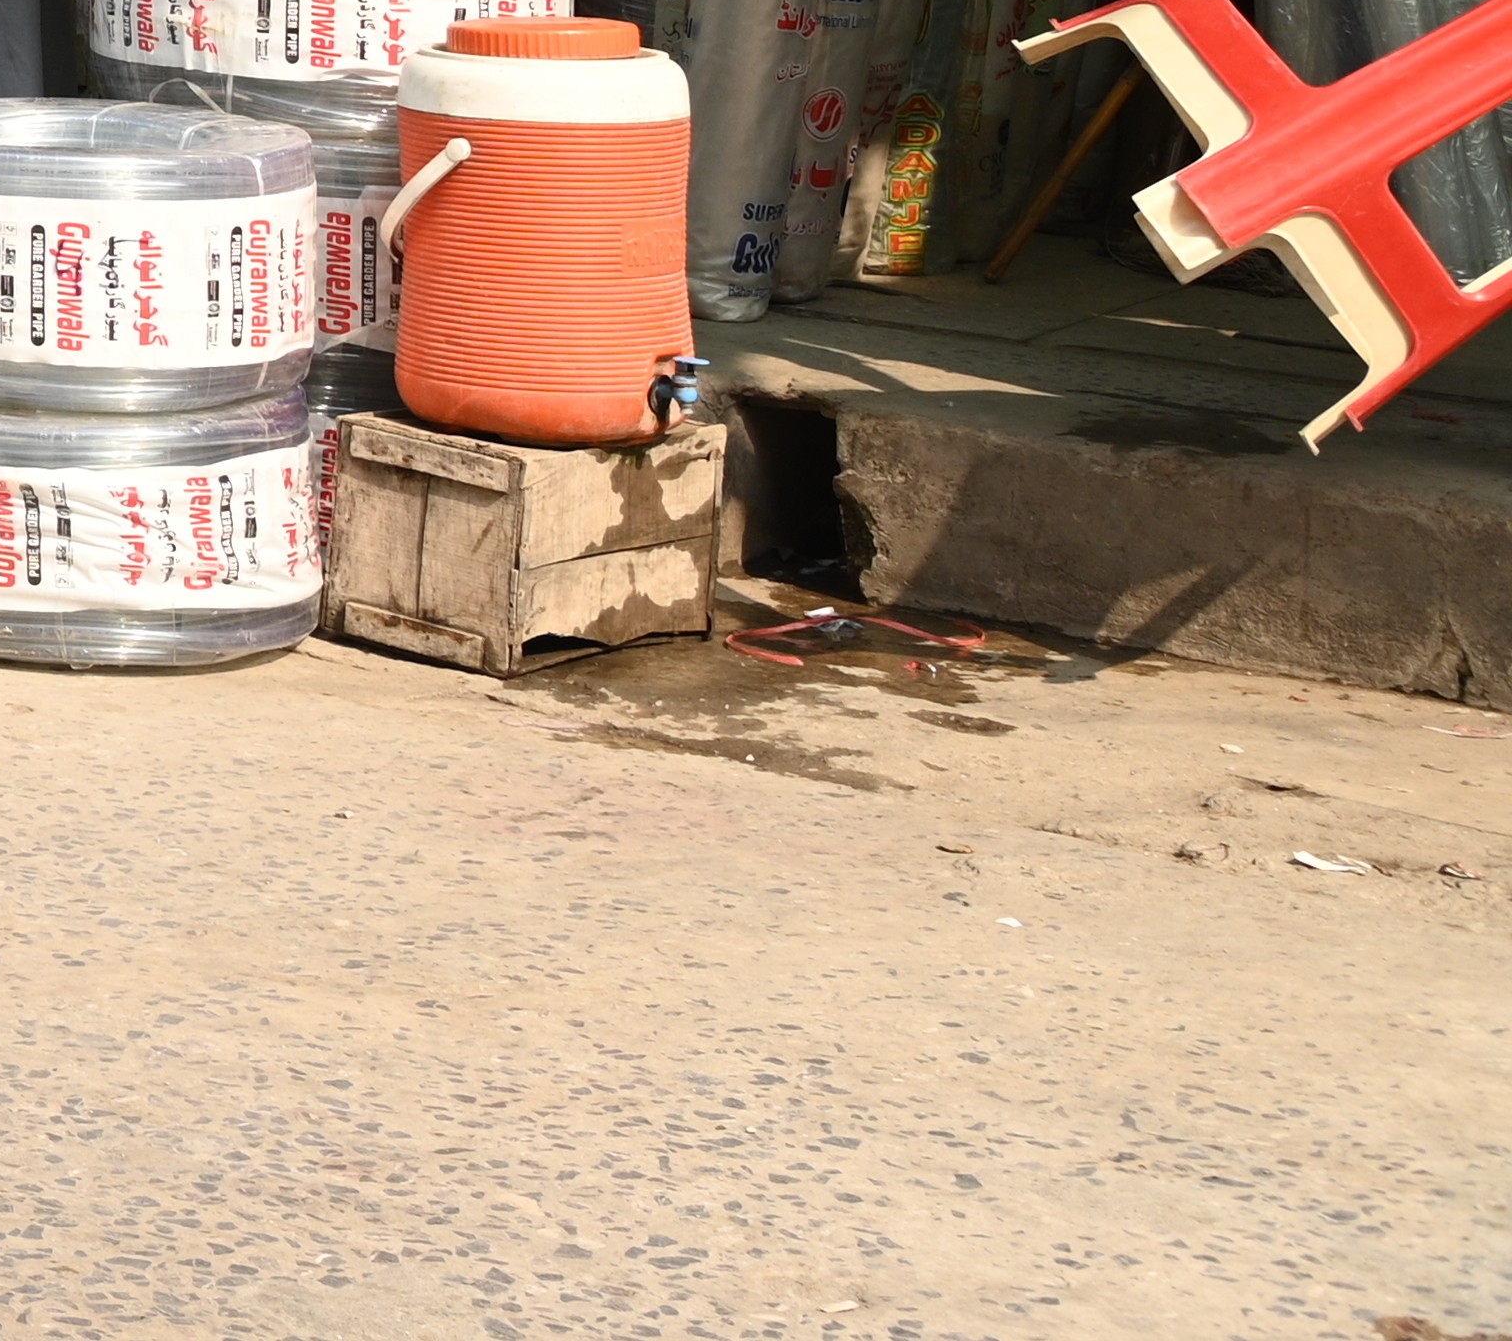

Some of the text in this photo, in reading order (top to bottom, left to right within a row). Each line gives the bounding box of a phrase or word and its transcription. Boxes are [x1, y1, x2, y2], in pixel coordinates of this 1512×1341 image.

[285, 31, 300, 58] PIPE
[30, 232, 44, 338] PURE GARDEN PIPE
[54, 221, 92, 351] Gujranwala
[134, 229, 169, 348] گوجرانوالہ
[231, 233, 244, 339] PURE GARDEN PIPE
[247, 219, 272, 348] Gujranwala
[292, 218, 307, 335] گوجرانوالہ
[316, 209, 353, 336] Gujranwala
[363, 217, 377, 326] PURE GARDEN PIPE
